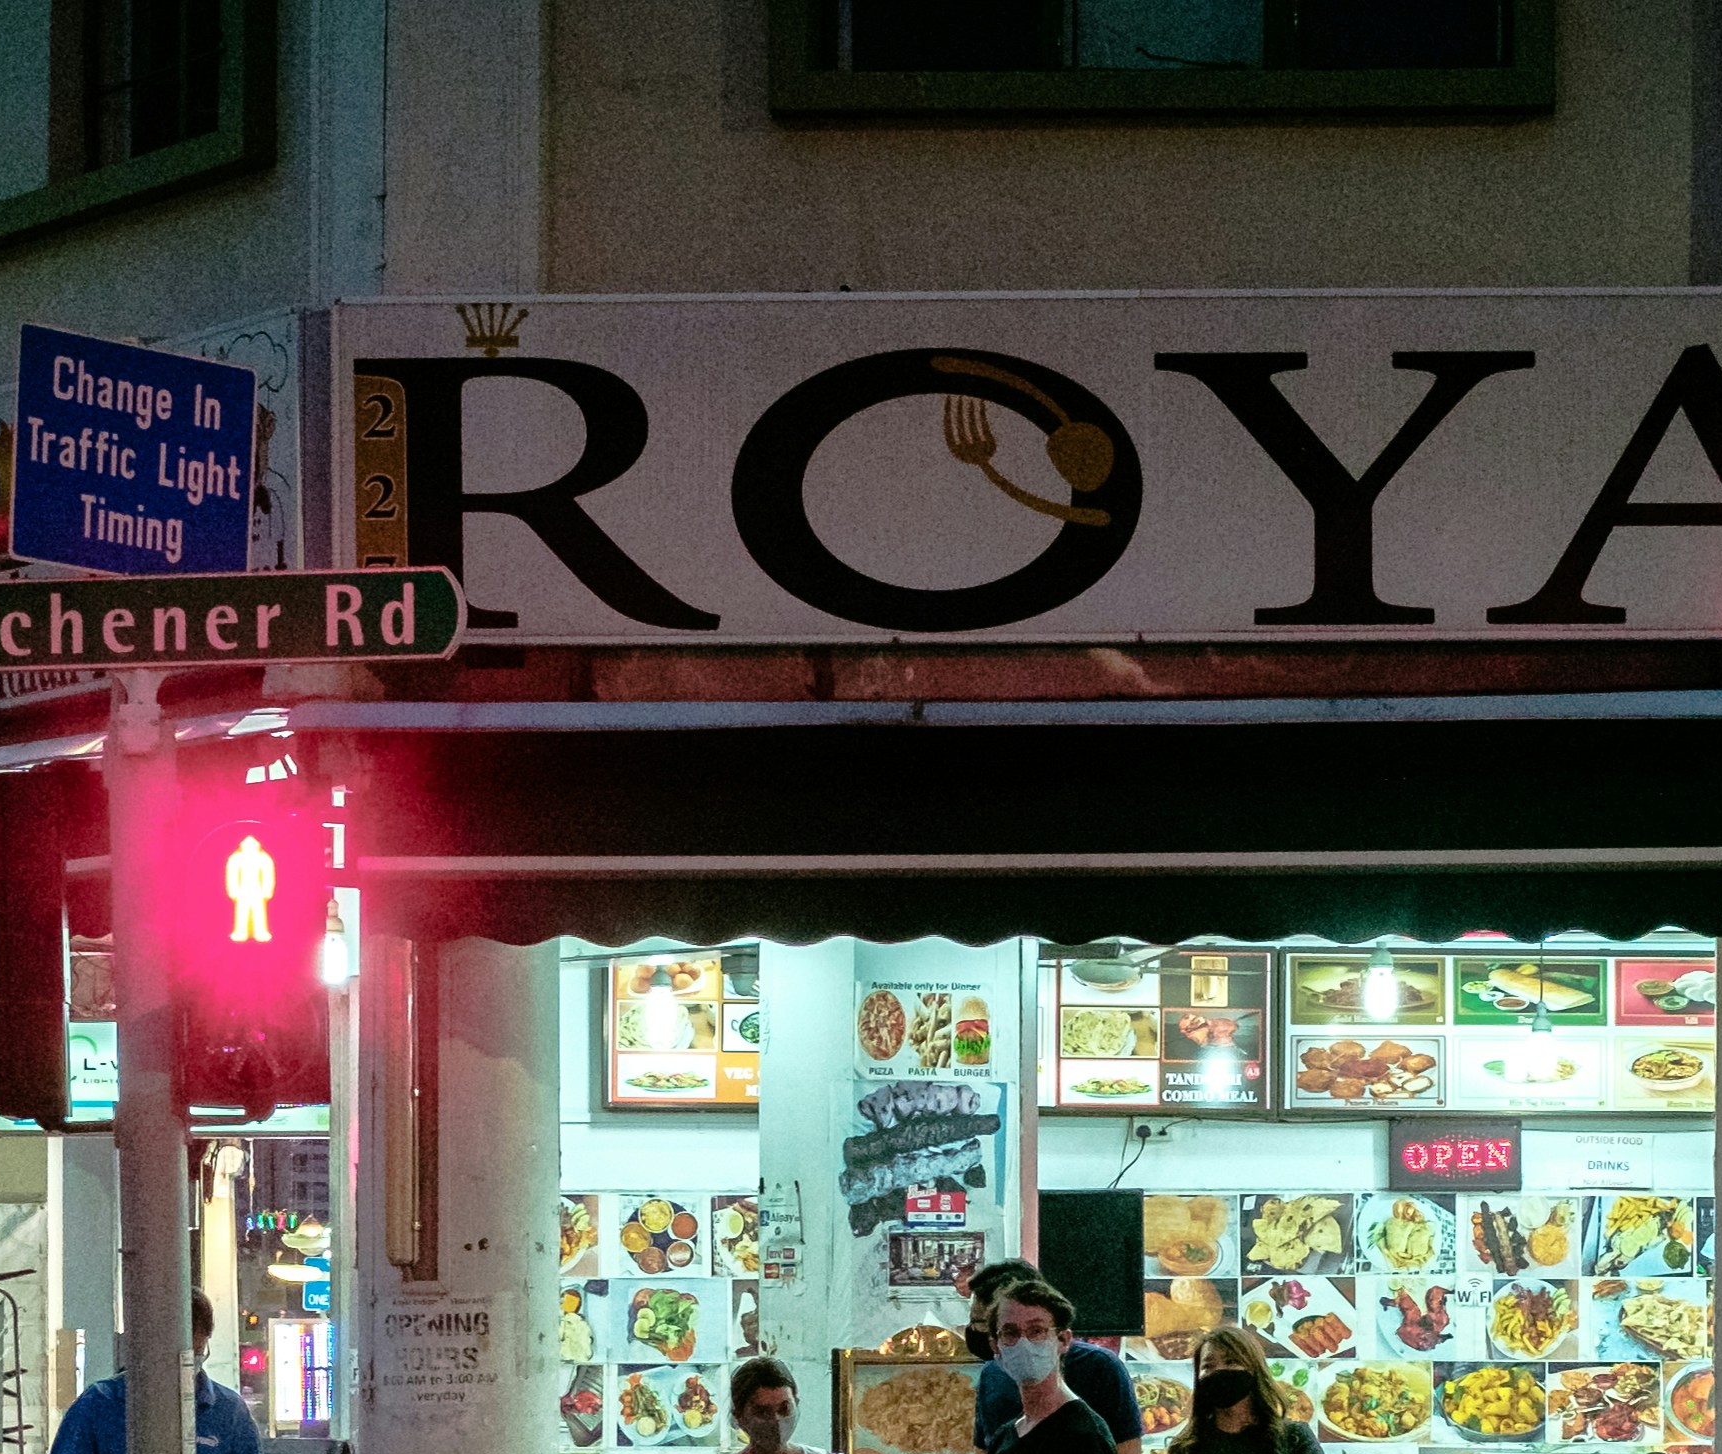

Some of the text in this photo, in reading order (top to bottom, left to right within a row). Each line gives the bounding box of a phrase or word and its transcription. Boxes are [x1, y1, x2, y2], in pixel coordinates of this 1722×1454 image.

[53, 356, 221, 431] Change In
[27, 417, 241, 510] Traffic Light
[361, 392, 398, 567] 22
[80, 492, 183, 564] Timing
[326, 583, 416, 648] Rd
[871, 981, 981, 993] Available only for Dinner
[723, 1067, 754, 1080] VEG
[868, 1067, 991, 1078] PIZZA PASTA BURGER
[1165, 1073, 1242, 1086] TANDRI
[1161, 1090, 1258, 1103] COMBO MEAL
[1575, 1135, 1644, 1146] OUTSIDE FOOD
[1403, 1138, 1512, 1174] OPEN
[1587, 1160, 1630, 1171] DRINKS
[384, 1312, 490, 1338] OPENING
[412, 1390, 466, 1402] veryday
